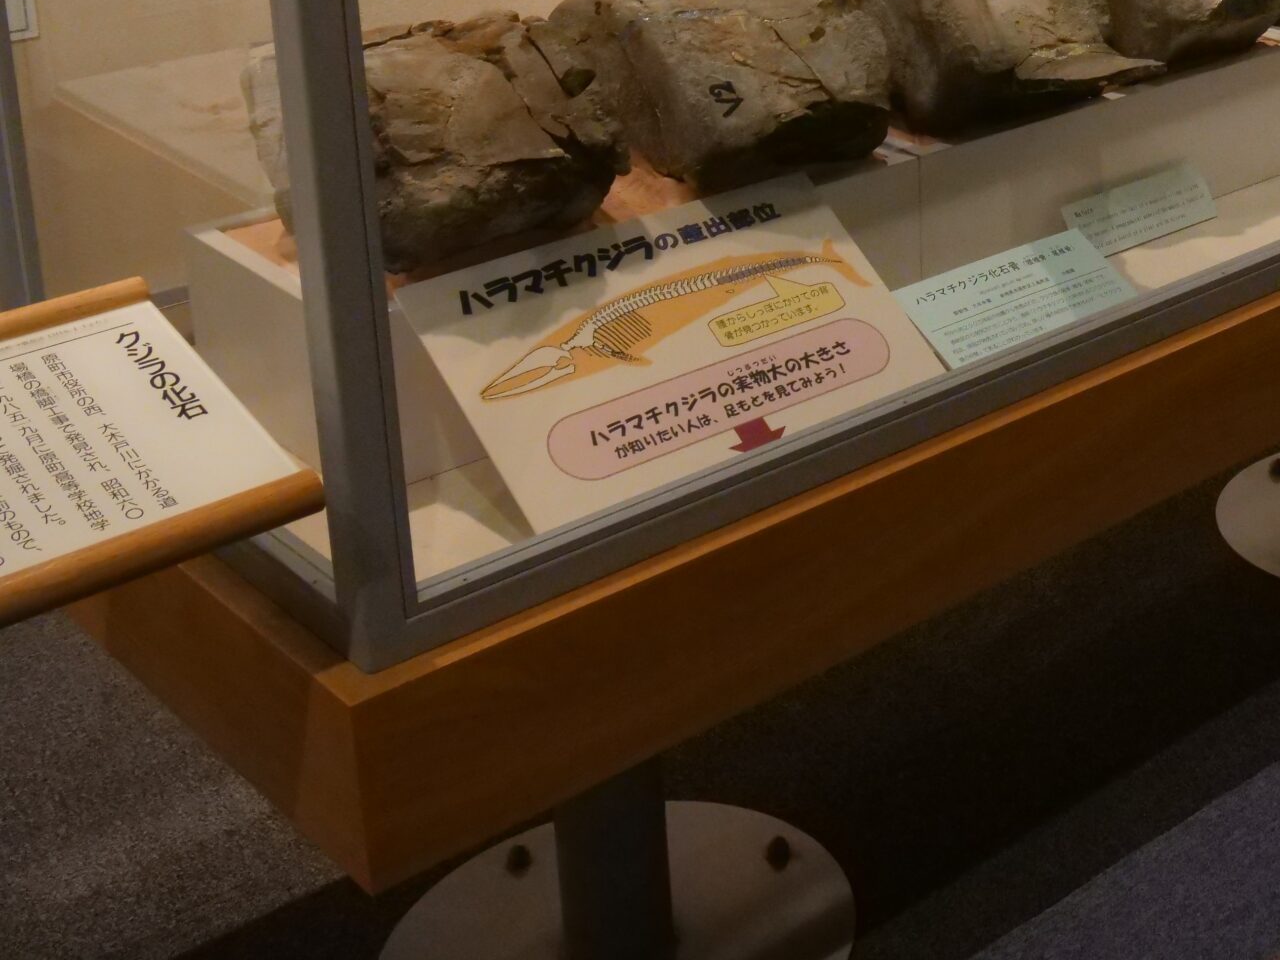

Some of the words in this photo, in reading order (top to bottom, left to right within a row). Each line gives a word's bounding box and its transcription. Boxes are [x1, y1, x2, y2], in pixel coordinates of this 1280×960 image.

[459, 202, 781, 315] ハラマチクジラの産出部位
[916, 260, 1021, 306] ハラマチクジラ化石骨
[115, 330, 208, 420] クジラの化石
[590, 341, 851, 446] ハラマチクジラの実物大の大きさ
[614, 362, 847, 459] が知りたい人は、足もとを見てみよう！
